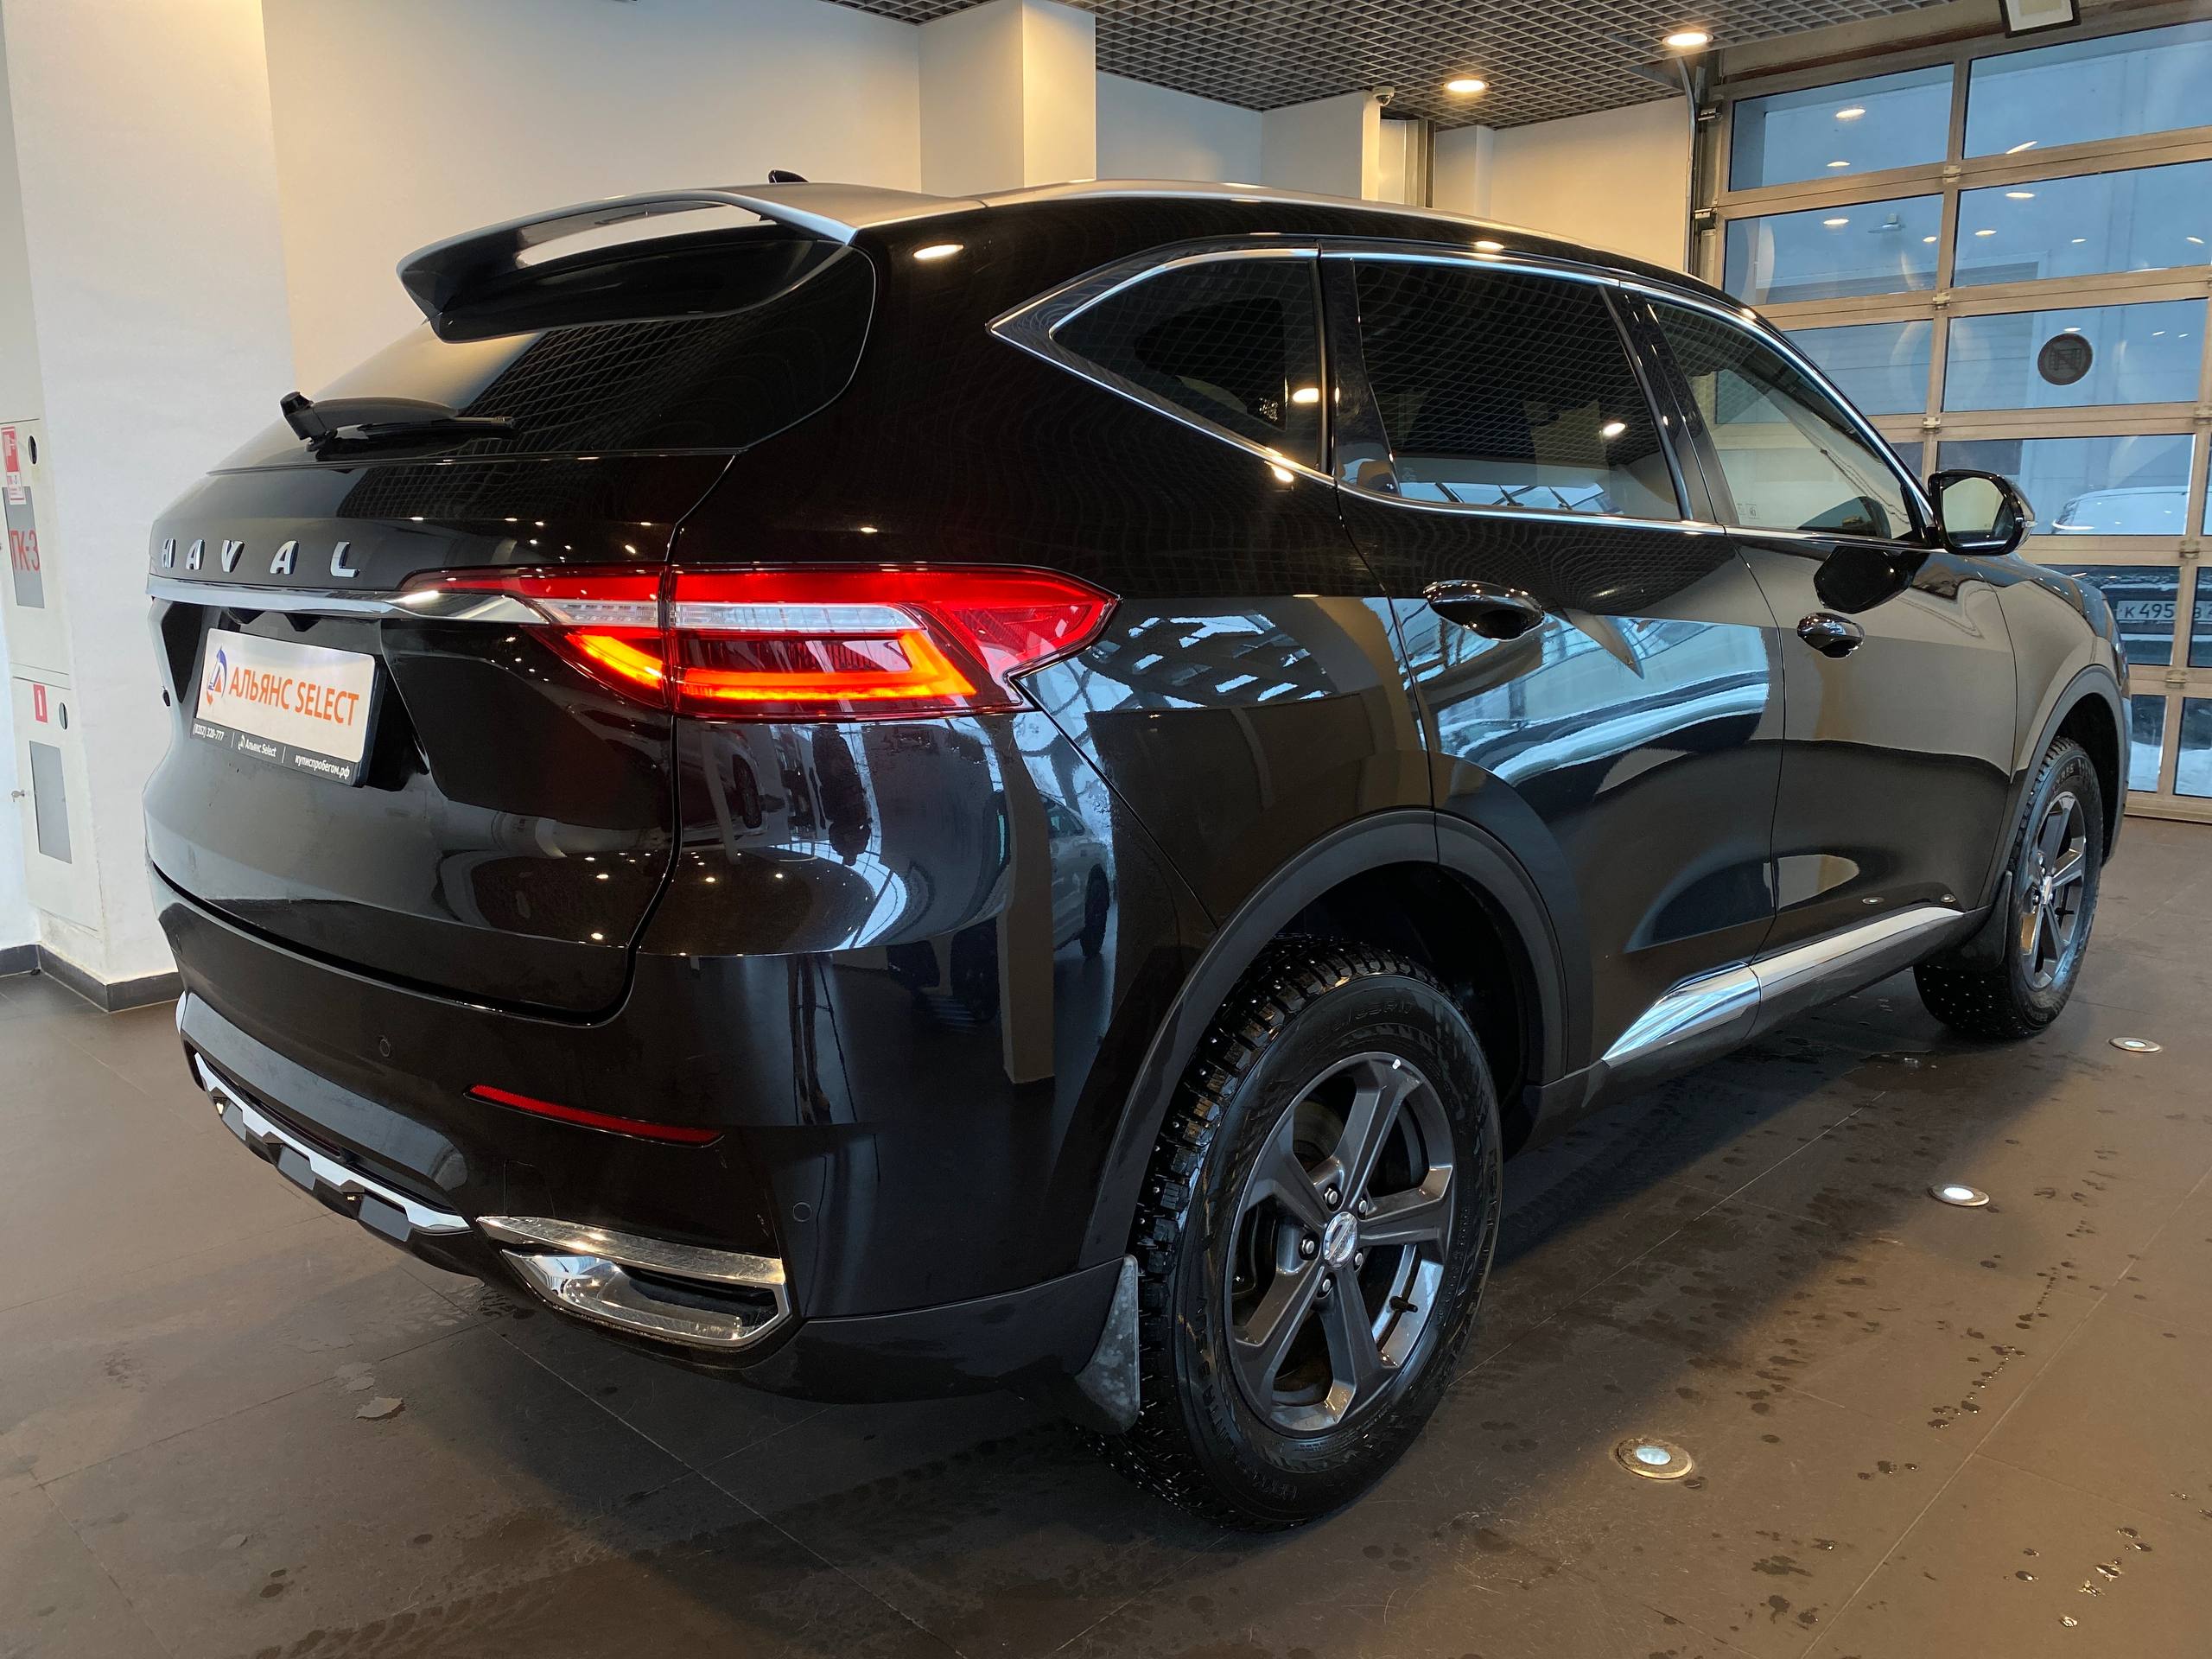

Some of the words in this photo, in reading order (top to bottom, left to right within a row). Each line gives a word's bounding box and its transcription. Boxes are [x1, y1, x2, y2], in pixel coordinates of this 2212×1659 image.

[162, 538, 359, 577] HAVAL
[228, 666, 294, 710] АЛЬЯНС
[295, 682, 359, 726] SELECT
[262, 744, 276, 757] Select
